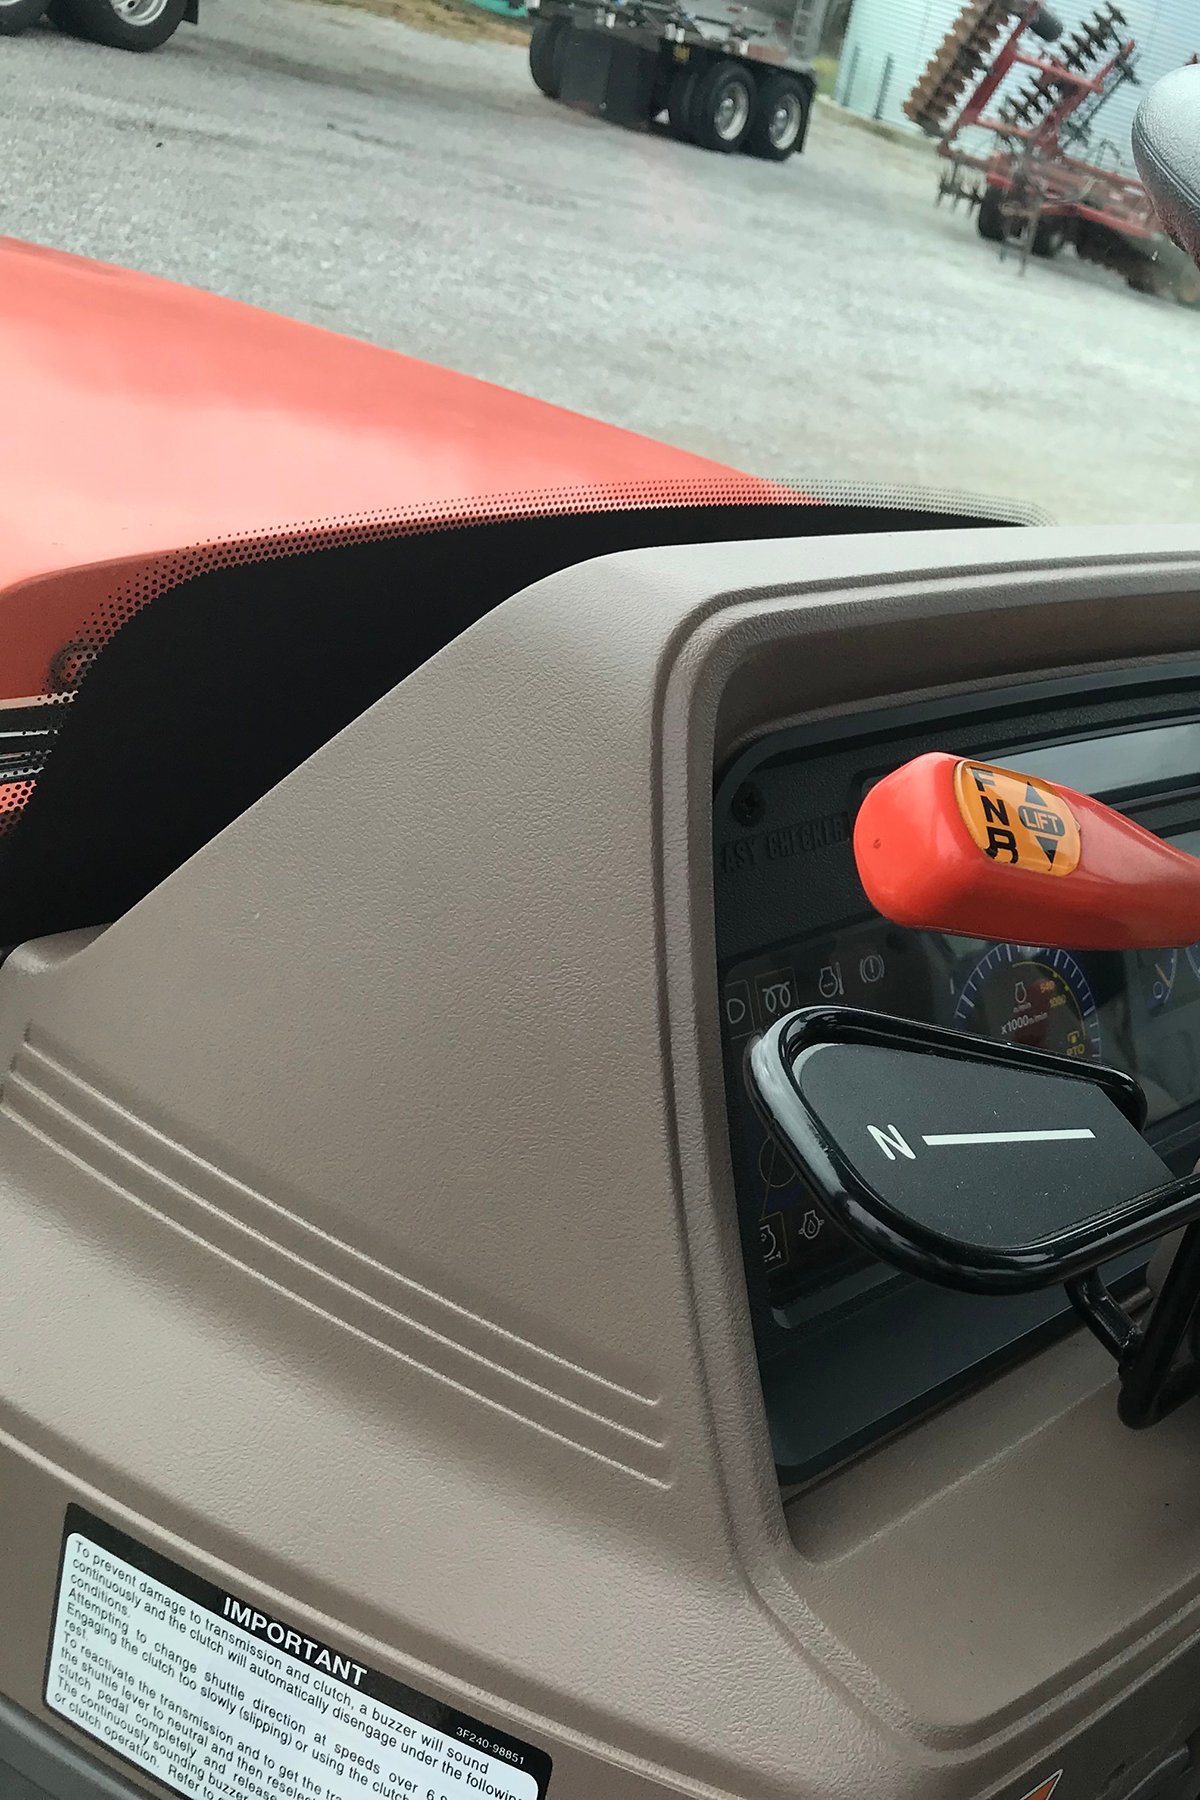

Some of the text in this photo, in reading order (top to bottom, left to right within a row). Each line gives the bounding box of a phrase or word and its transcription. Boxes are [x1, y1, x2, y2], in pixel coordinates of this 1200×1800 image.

[970, 766, 995, 792] F
[980, 795, 1010, 826] N
[1023, 809, 1058, 834] LIFT
[984, 826, 1019, 864] R
[866, 1124, 917, 1161] N
[64, 1619, 88, 1641] rest.
[71, 1574, 131, 1618] conditions.
[223, 1596, 368, 1686] IMPORTANT
[67, 1602, 117, 1645] Engaging
[121, 1637, 138, 1655] the
[142, 1652, 175, 1678] clutch
[179, 1672, 197, 1691] too
[200, 1686, 237, 1715] slowly
[239, 1706, 293, 1746] (slipping)
[295, 1740, 308, 1753] or
[312, 1749, 345, 1776] using
[349, 1766, 368, 1786] the
[68, 1588, 418, 1793] Attempting to change shuttle direction at speeds over
[72, 1559, 141, 1608] continuously
[144, 1602, 166, 1621] and
[169, 1615, 187, 1633] the
[190, 1629, 224, 1655] clutch
[227, 1652, 248, 1668] will
[250, 1662, 329, 1714] automatically
[332, 1706, 397, 1748] disengage
[401, 1743, 438, 1768] under
[442, 1761, 462, 1780] the
[466, 1772, 522, 1800] followin
[76, 1540, 490, 1775] To prevent damage to transmission and clutch, a buzzer will sound
[54, 1693, 214, 1800] or clutch operation. Refer to
[57, 1675, 78, 1697] The
[81, 1694, 150, 1746] continuously
[153, 1740, 205, 1782] sounding
[58, 1663, 91, 1691] clutch
[97, 1689, 129, 1715] pedal
[135, 1713, 197, 1759] completely
[203, 1756, 226, 1775] and
[60, 1647, 78, 1664] the
[81, 1662, 118, 1692] shuttle
[122, 1686, 149, 1711] lever
[153, 1706, 164, 1720] to
[167, 1717, 208, 1748] neutral
[211, 1743, 234, 1762] and
[237, 1756, 263, 1780] then
[267, 1775, 316, 1800] resele
[63, 1631, 77, 1648] To
[80, 1645, 135, 1686] reactivate
[138, 1680, 156, 1699] the
[160, 1693, 234, 1745] transmission
[237, 1741, 260, 1761] and
[264, 1754, 275, 1769] to
[279, 1765, 298, 1783] get
[302, 1776, 322, 1795] the
[455, 1726, 525, 1765] 3F240-98851
